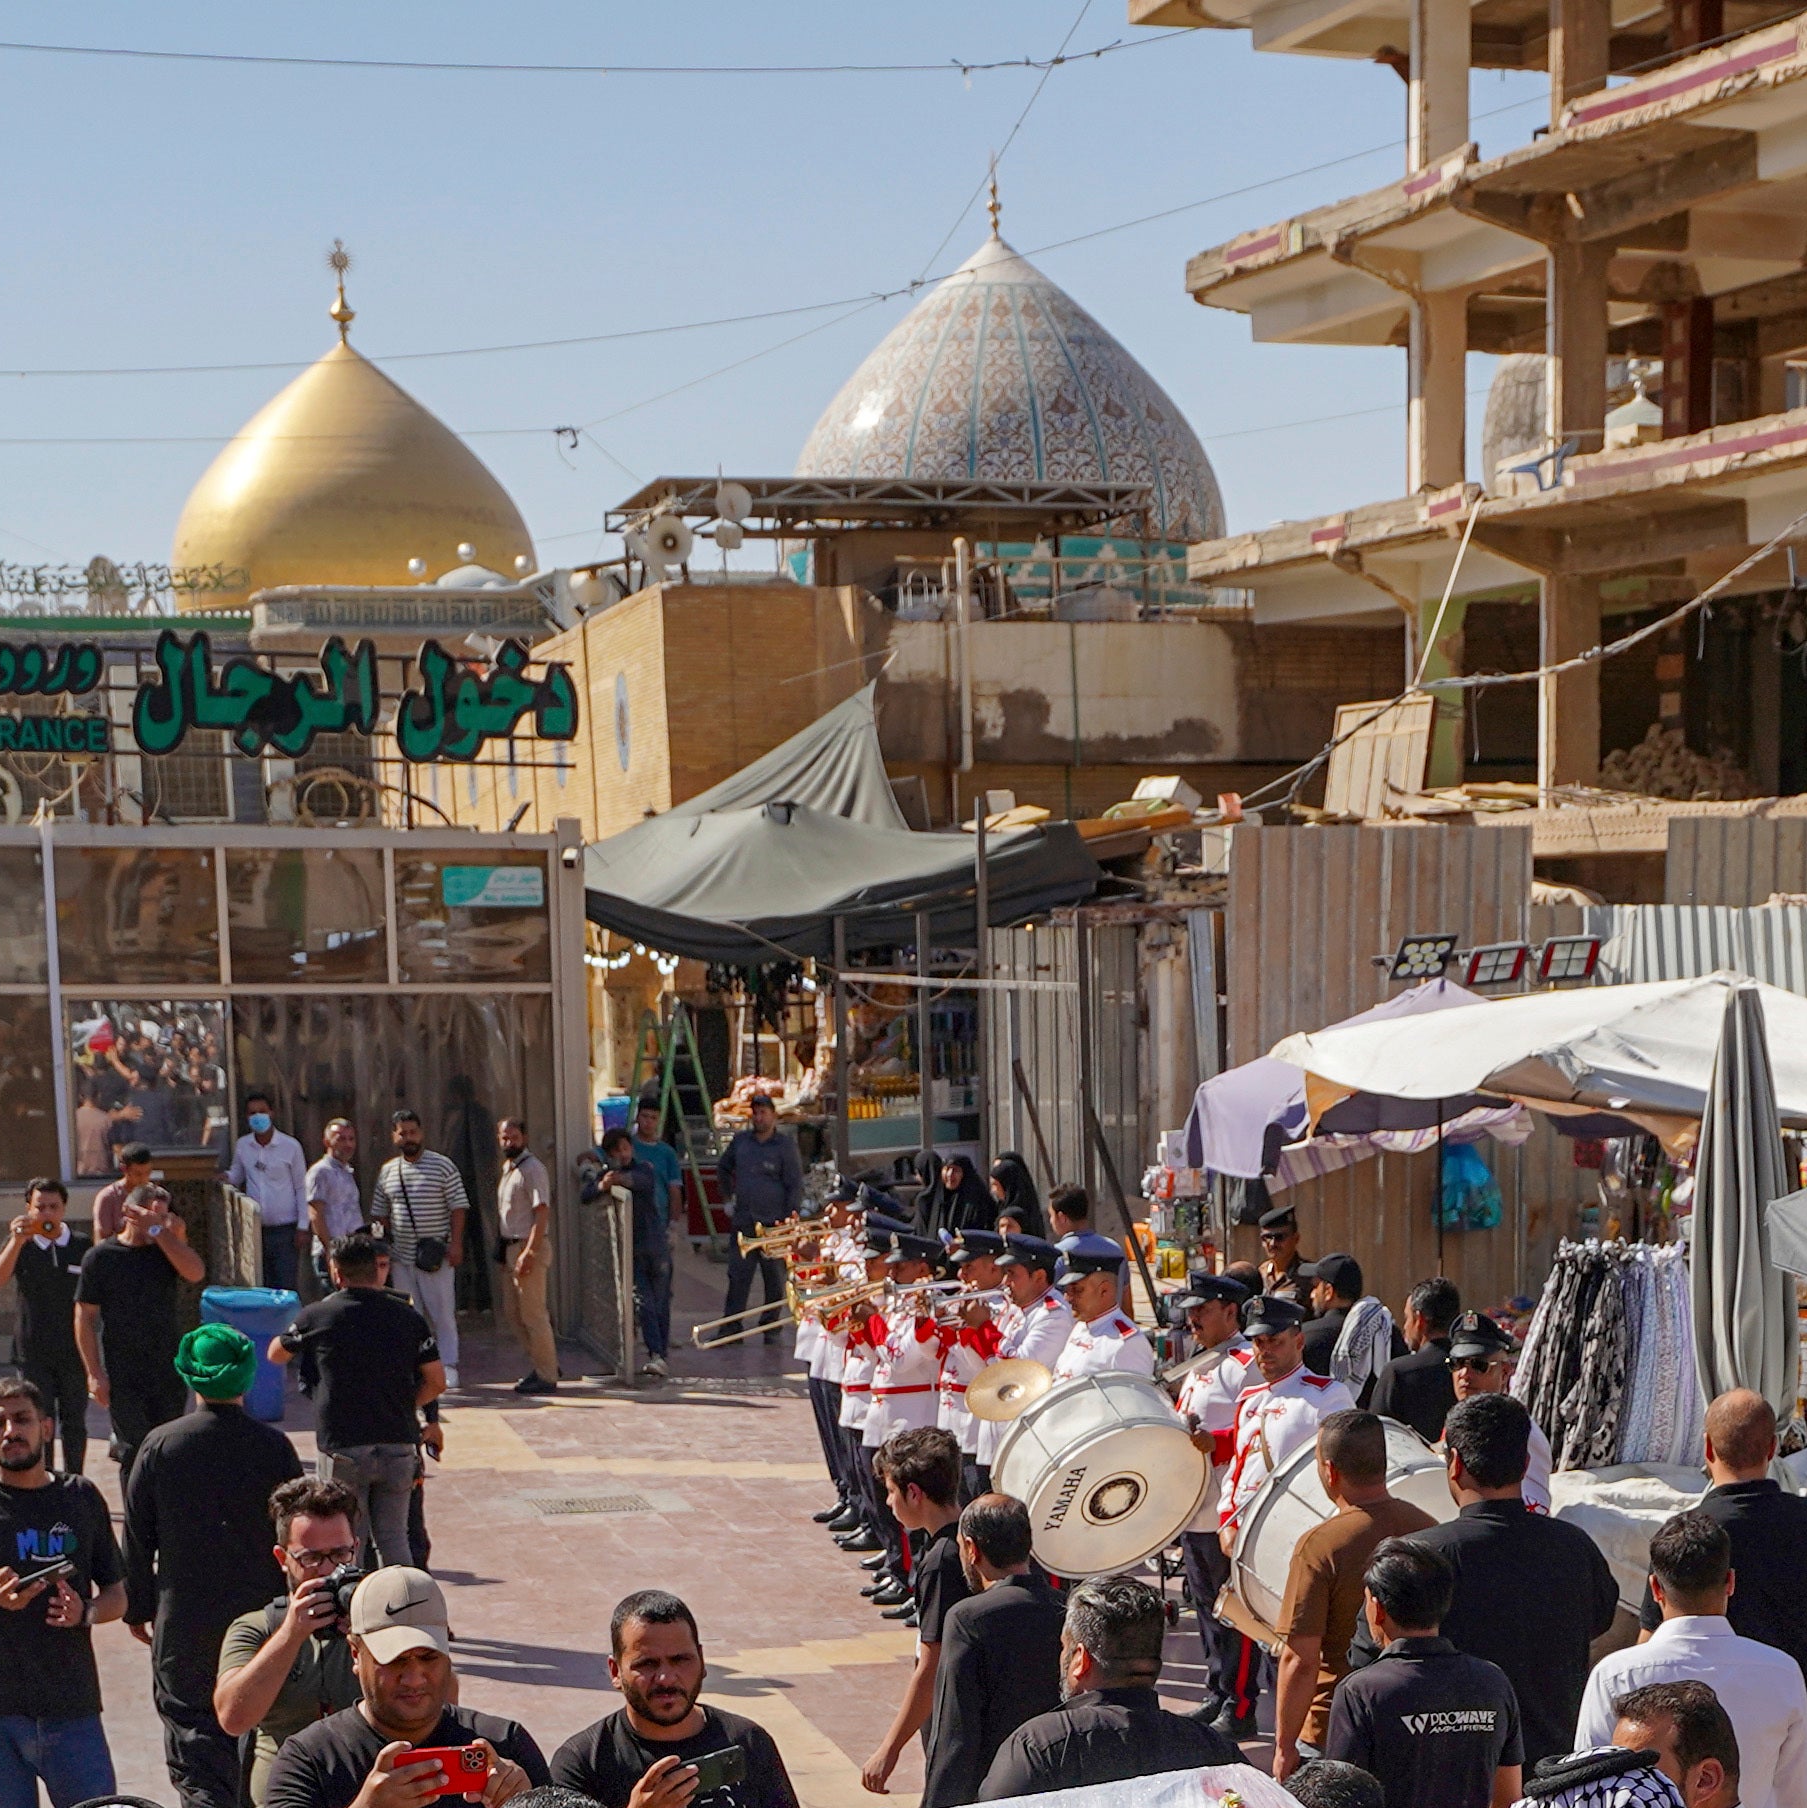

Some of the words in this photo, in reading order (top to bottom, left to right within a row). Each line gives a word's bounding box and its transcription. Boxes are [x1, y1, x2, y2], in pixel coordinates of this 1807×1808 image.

[134, 631, 377, 756] الرجال
[399, 640, 578, 760] دخول
[1043, 1465, 1088, 1532] YAMAHA
[1430, 1710, 1497, 1727] PROWAVE
